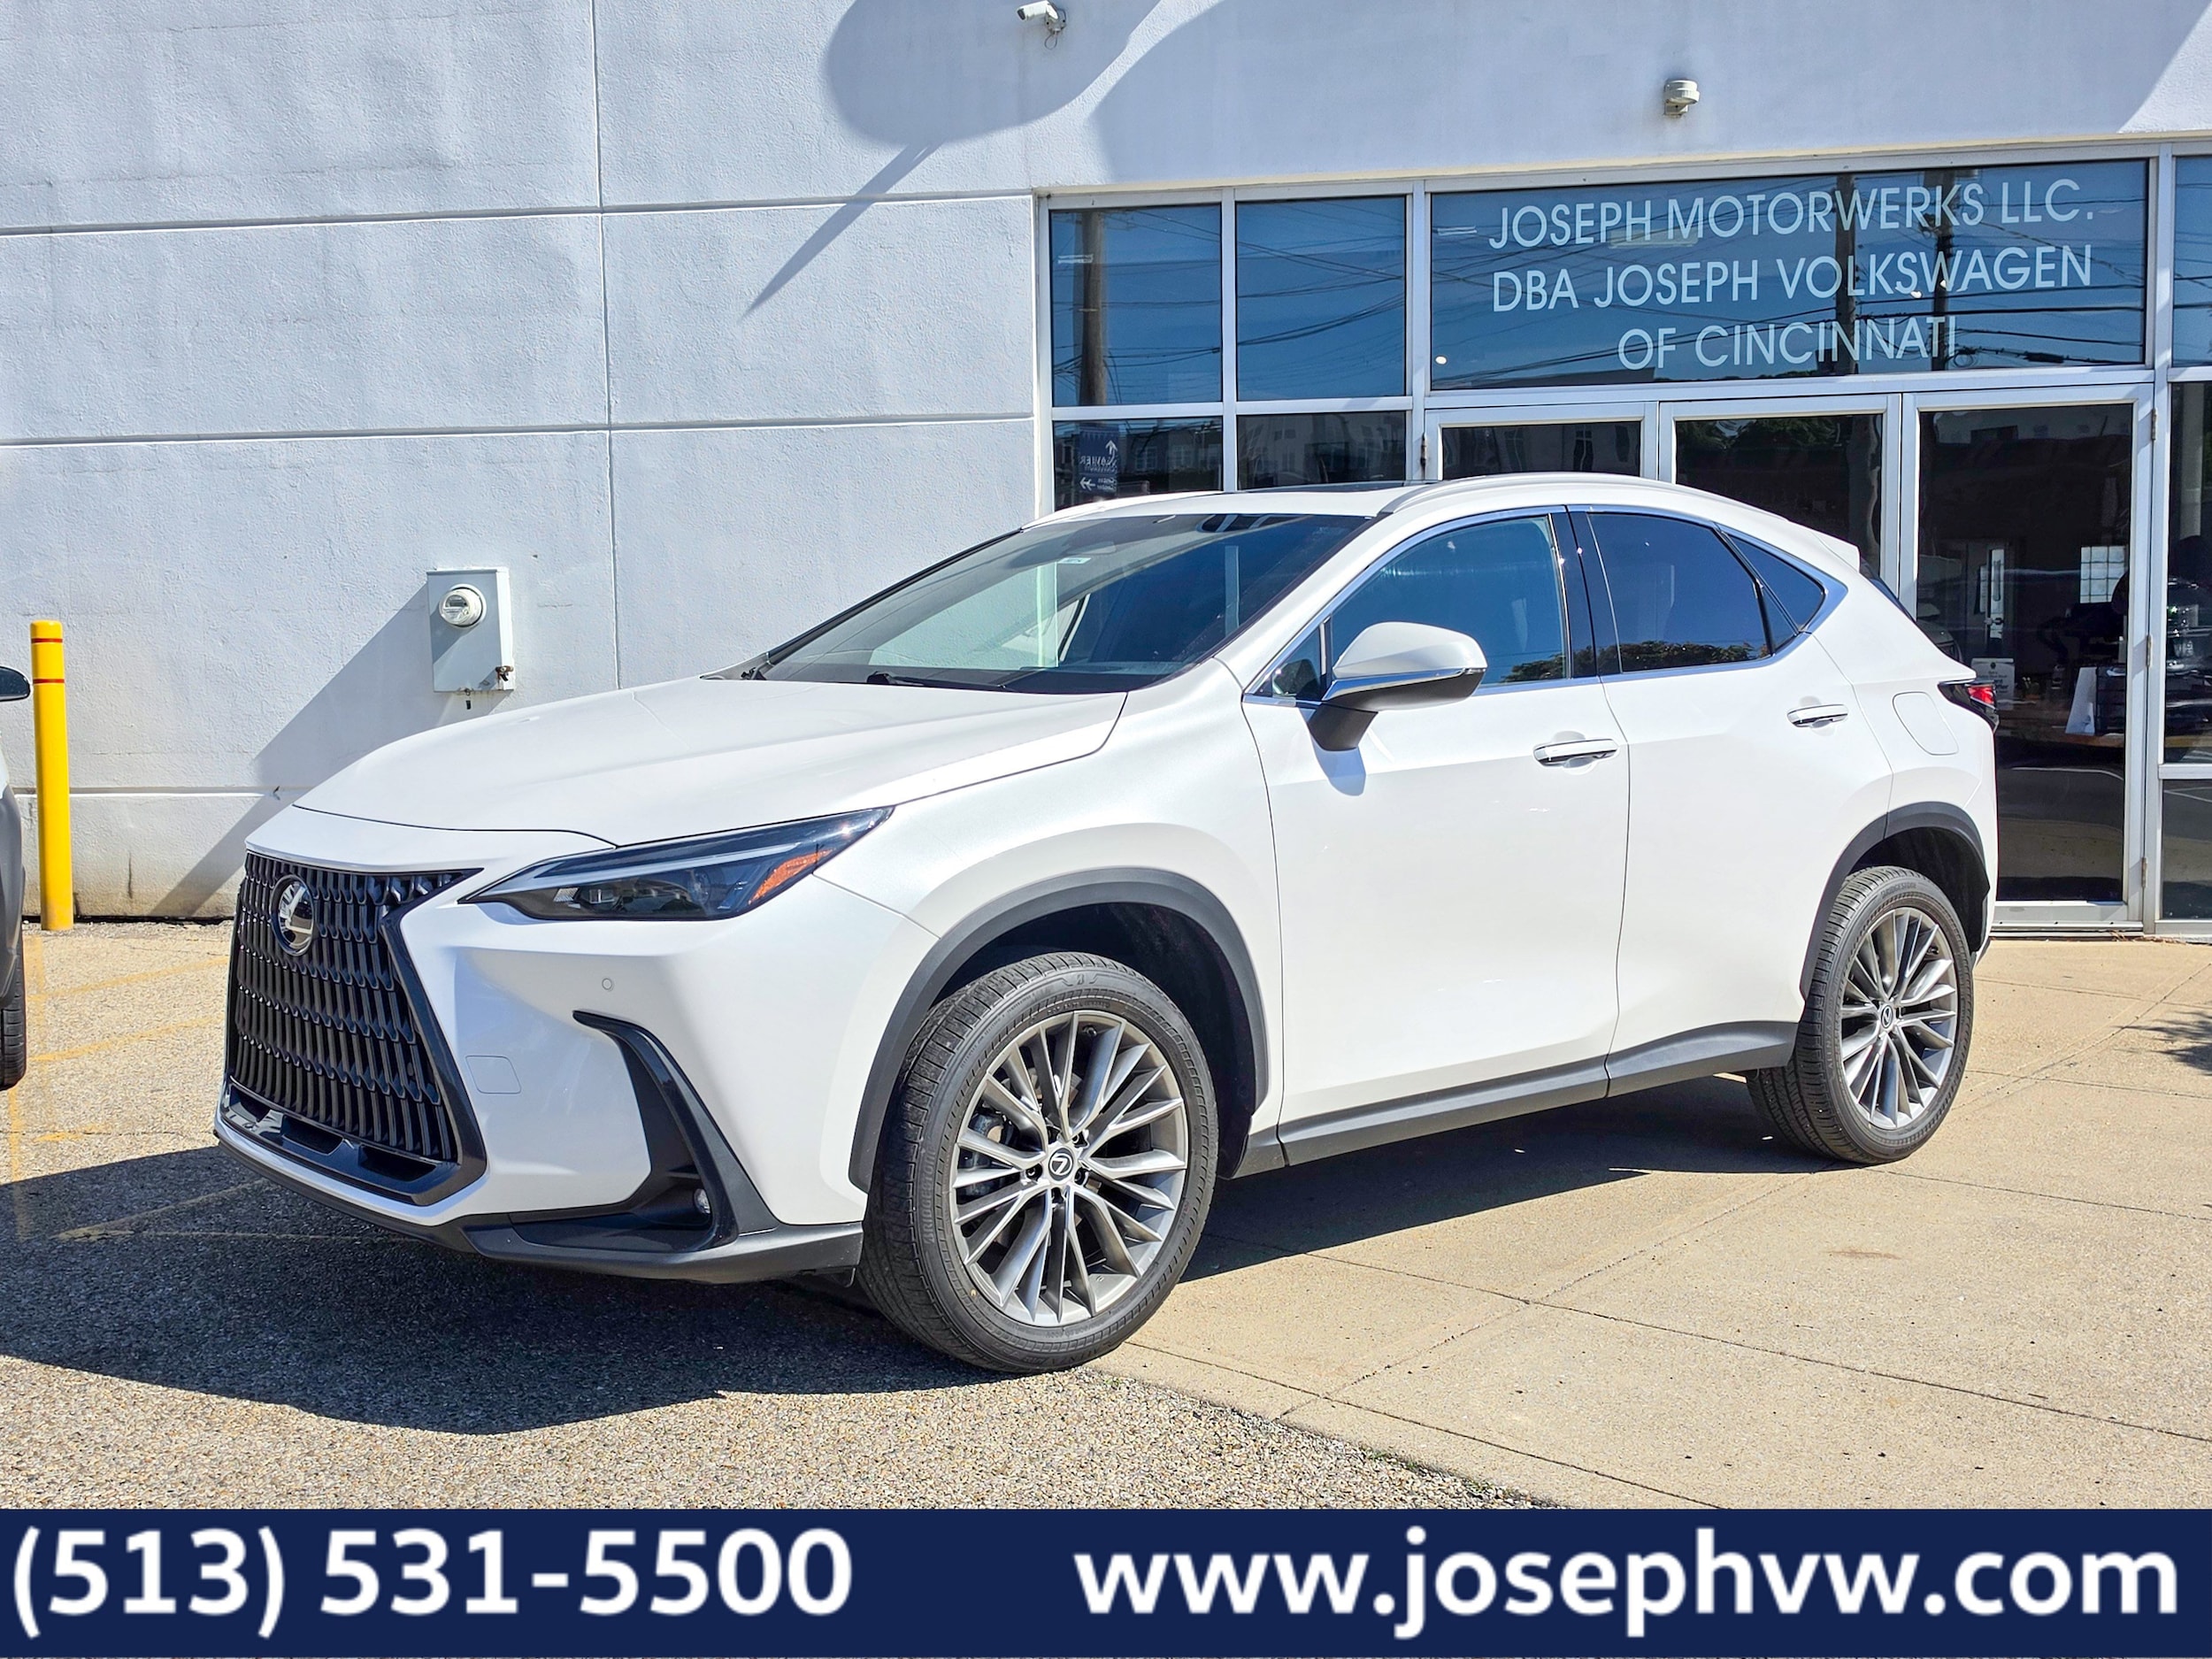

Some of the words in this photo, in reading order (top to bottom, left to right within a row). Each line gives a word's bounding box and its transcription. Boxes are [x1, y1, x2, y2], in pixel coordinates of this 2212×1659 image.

[1488, 200, 1652, 250] JOSEPH
[1667, 183, 1985, 239] MOTORWERKS
[2001, 179, 2094, 225] LLC.
[1493, 268, 1579, 312] DBA
[1594, 259, 1758, 308] JOSEPH
[1776, 244, 2092, 299] VOLKSWAGEN
[1617, 327, 1677, 370] OF
[1694, 315, 1956, 368] CINCINNATI
